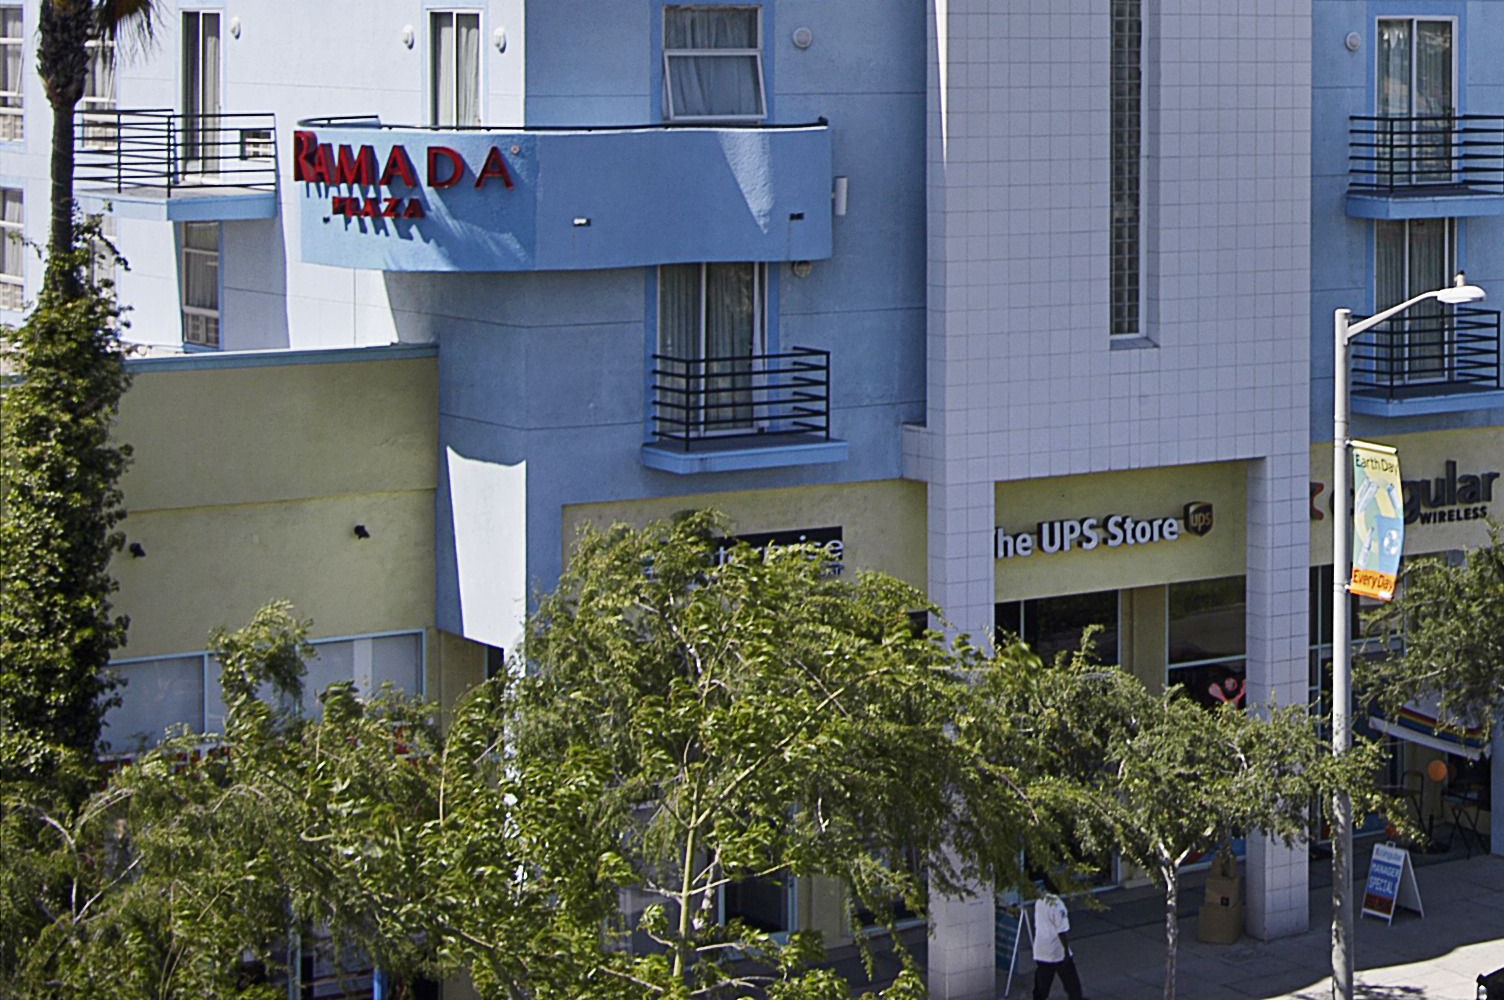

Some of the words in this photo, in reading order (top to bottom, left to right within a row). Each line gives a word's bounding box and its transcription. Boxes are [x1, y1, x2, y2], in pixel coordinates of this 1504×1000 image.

[293, 130, 514, 189] RAMADA
[1355, 454, 1380, 468] Earth
[1190, 515, 1212, 535] ups
[1419, 506, 1488, 525] WIRELESS
[1038, 517, 1098, 554] UPS
[1104, 514, 1179, 548] Store
[1353, 570, 1377, 590] Every
[1376, 573, 1393, 594] Day
